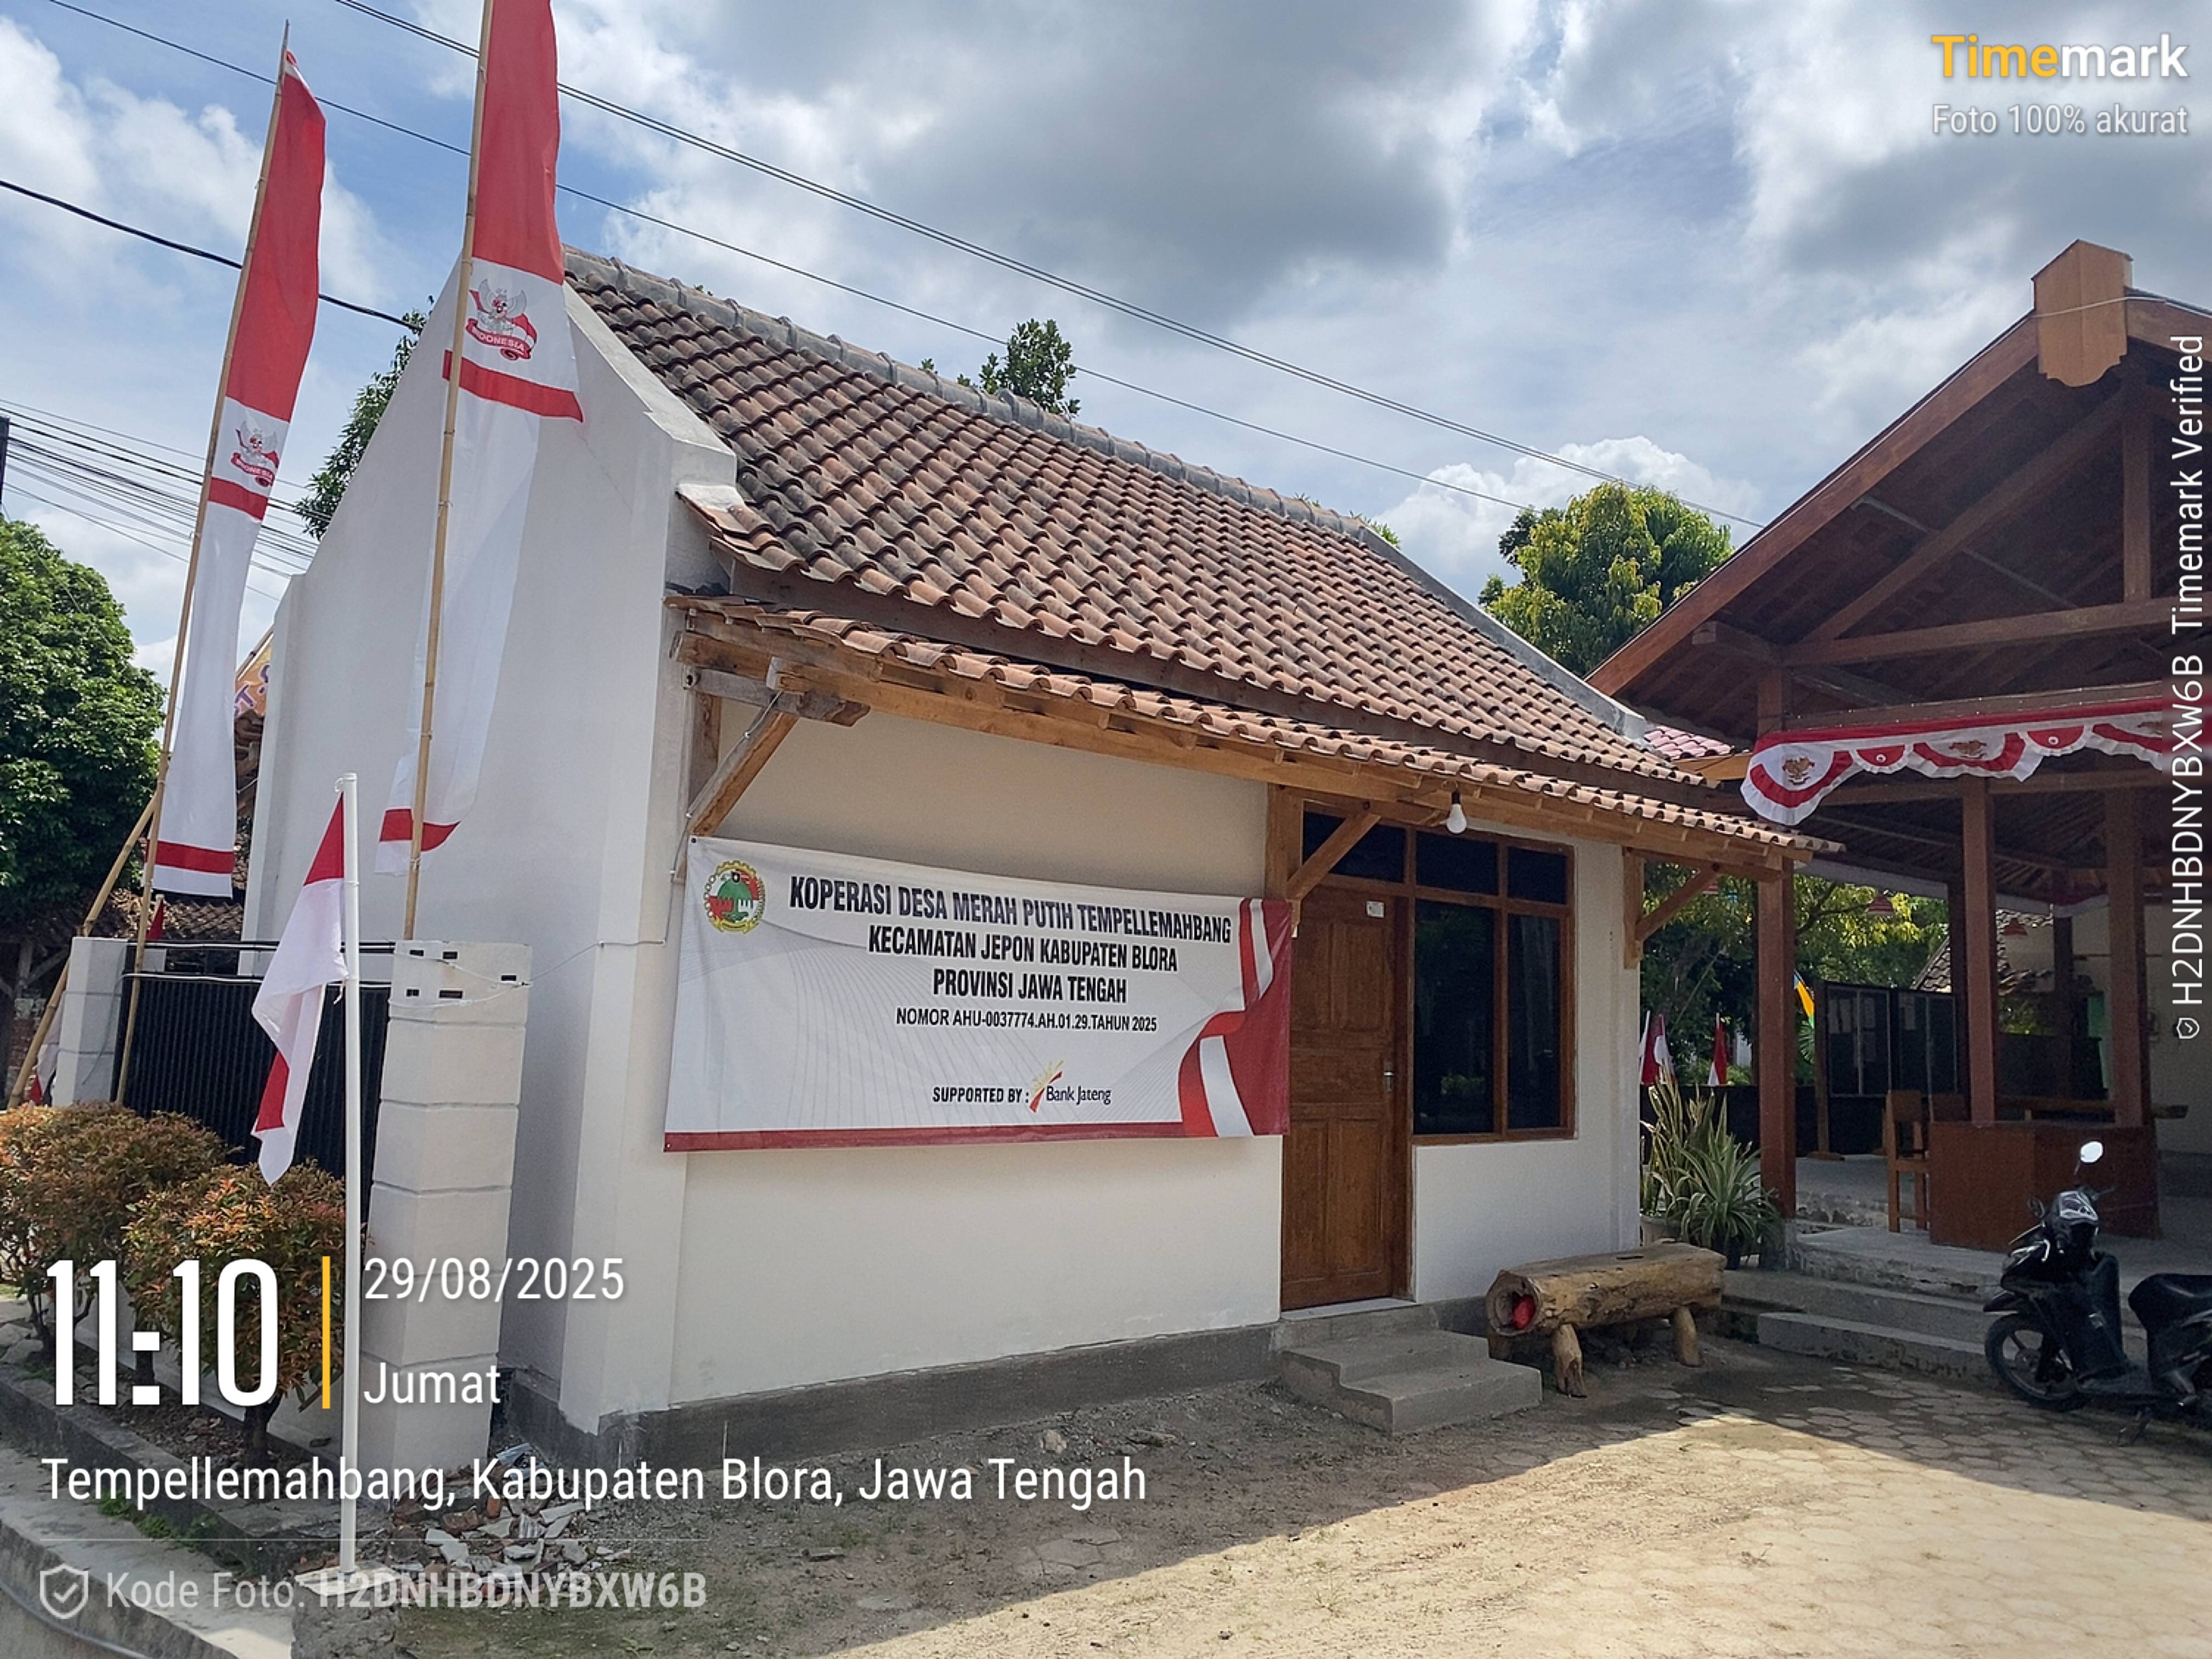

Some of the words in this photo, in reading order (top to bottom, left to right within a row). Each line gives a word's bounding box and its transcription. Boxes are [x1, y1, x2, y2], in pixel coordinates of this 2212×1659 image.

[789, 876, 891, 915] KOPERASI
[898, 886, 947, 919] DESA
[952, 892, 1017, 925] MERAH
[1022, 899, 1073, 930] PUTIH
[1076, 904, 1231, 944] TEMPELLEMAHBANG
[868, 924, 976, 958] KECAMATAN
[981, 933, 1035, 963] JEPON
[1040, 938, 1127, 969] KABUPATEN
[1131, 945, 1177, 972] BLORA
[933, 968, 1013, 998] PROVINSI
[1018, 973, 1063, 1001] JAWA
[1067, 975, 1127, 1003] TENGAH
[896, 1007, 950, 1025] NOMOR
[1132, 1015, 1157, 1031] 2025
[933, 1086, 1004, 1103] SUPPORTED
[1047, 1085, 1074, 1101] Bank
[1076, 1086, 1111, 1105] Jateng
